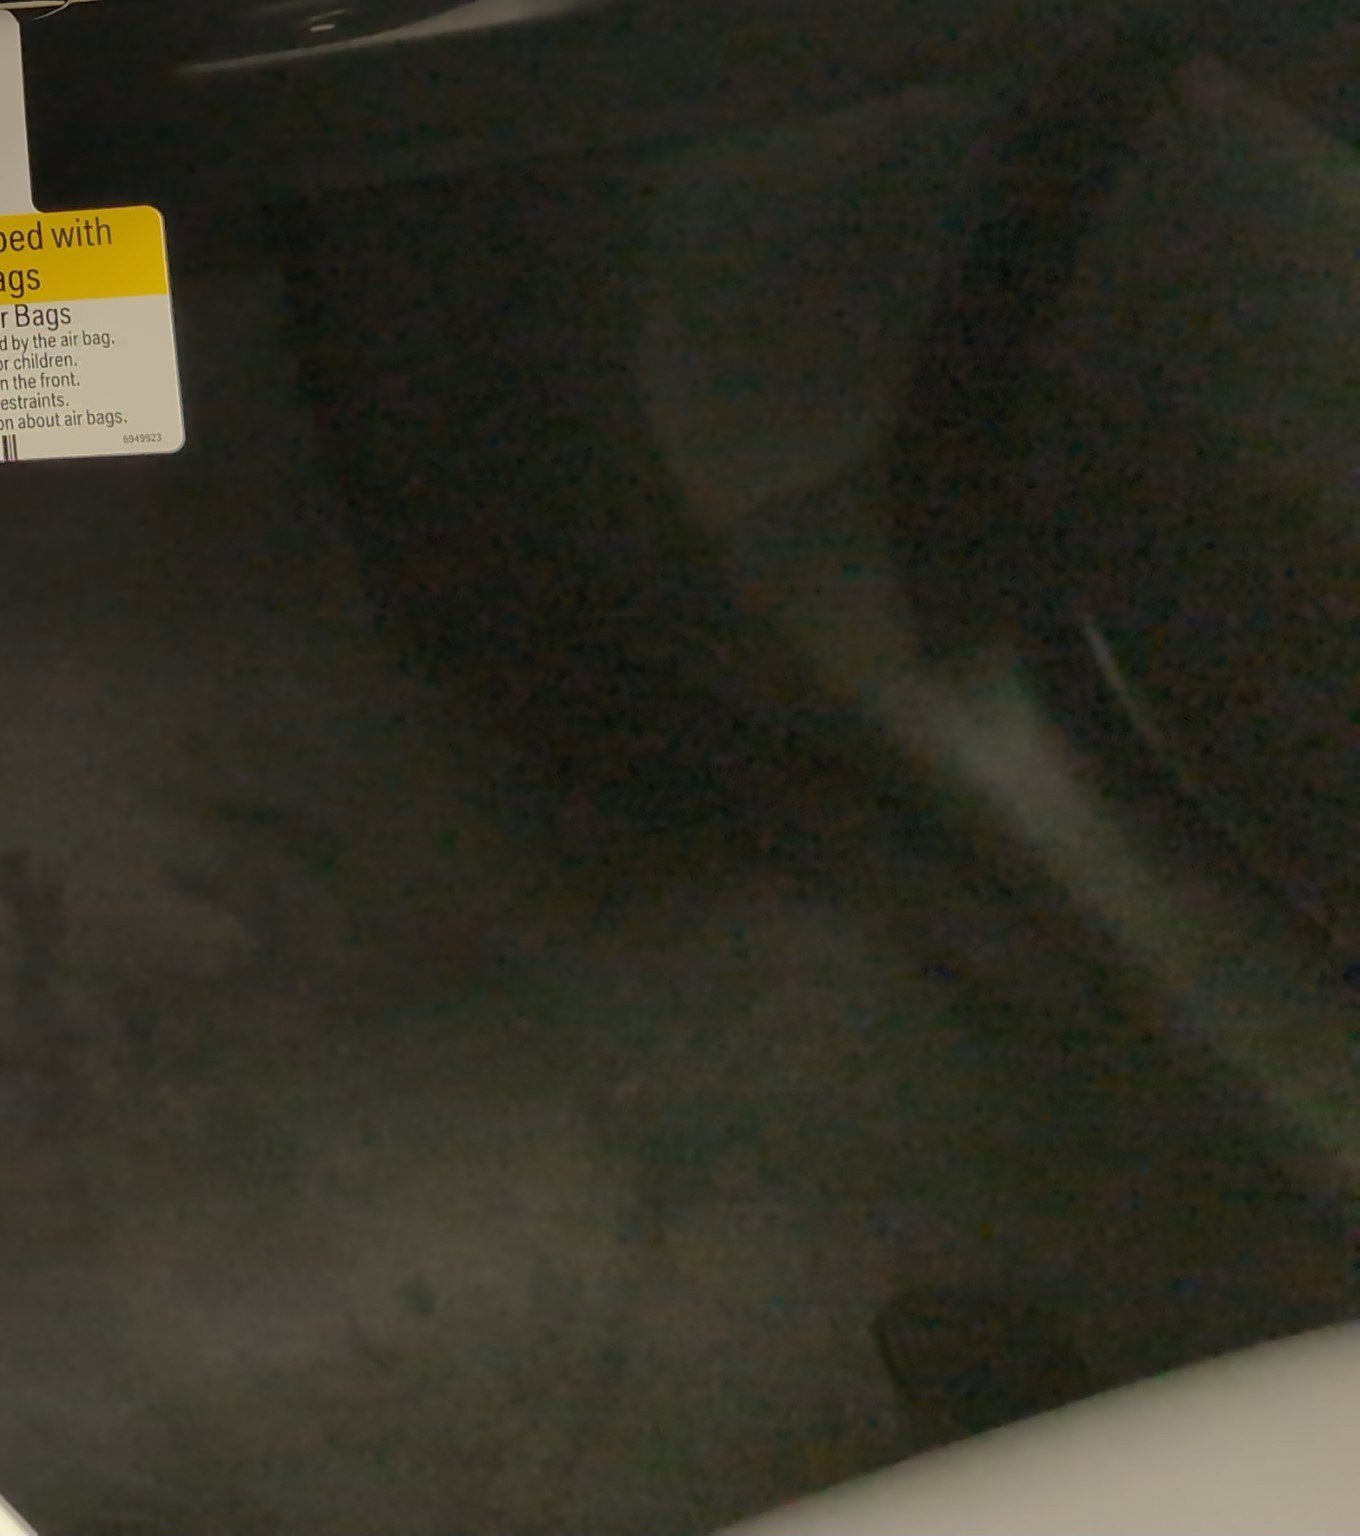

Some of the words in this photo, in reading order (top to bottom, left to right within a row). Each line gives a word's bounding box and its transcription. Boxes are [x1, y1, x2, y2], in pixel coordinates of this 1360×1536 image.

[51, 217, 112, 248] with
[14, 304, 71, 331] Bags
[12, 334, 28, 353] by
[33, 333, 56, 349] the
[60, 331, 79, 346] air
[82, 330, 115, 348] bag.
[13, 354, 78, 370] children.
[13, 374, 37, 390] the
[40, 372, 80, 388] front.
[18, 412, 60, 429] about
[64, 410, 84, 425] air
[86, 408, 127, 428] bags.
